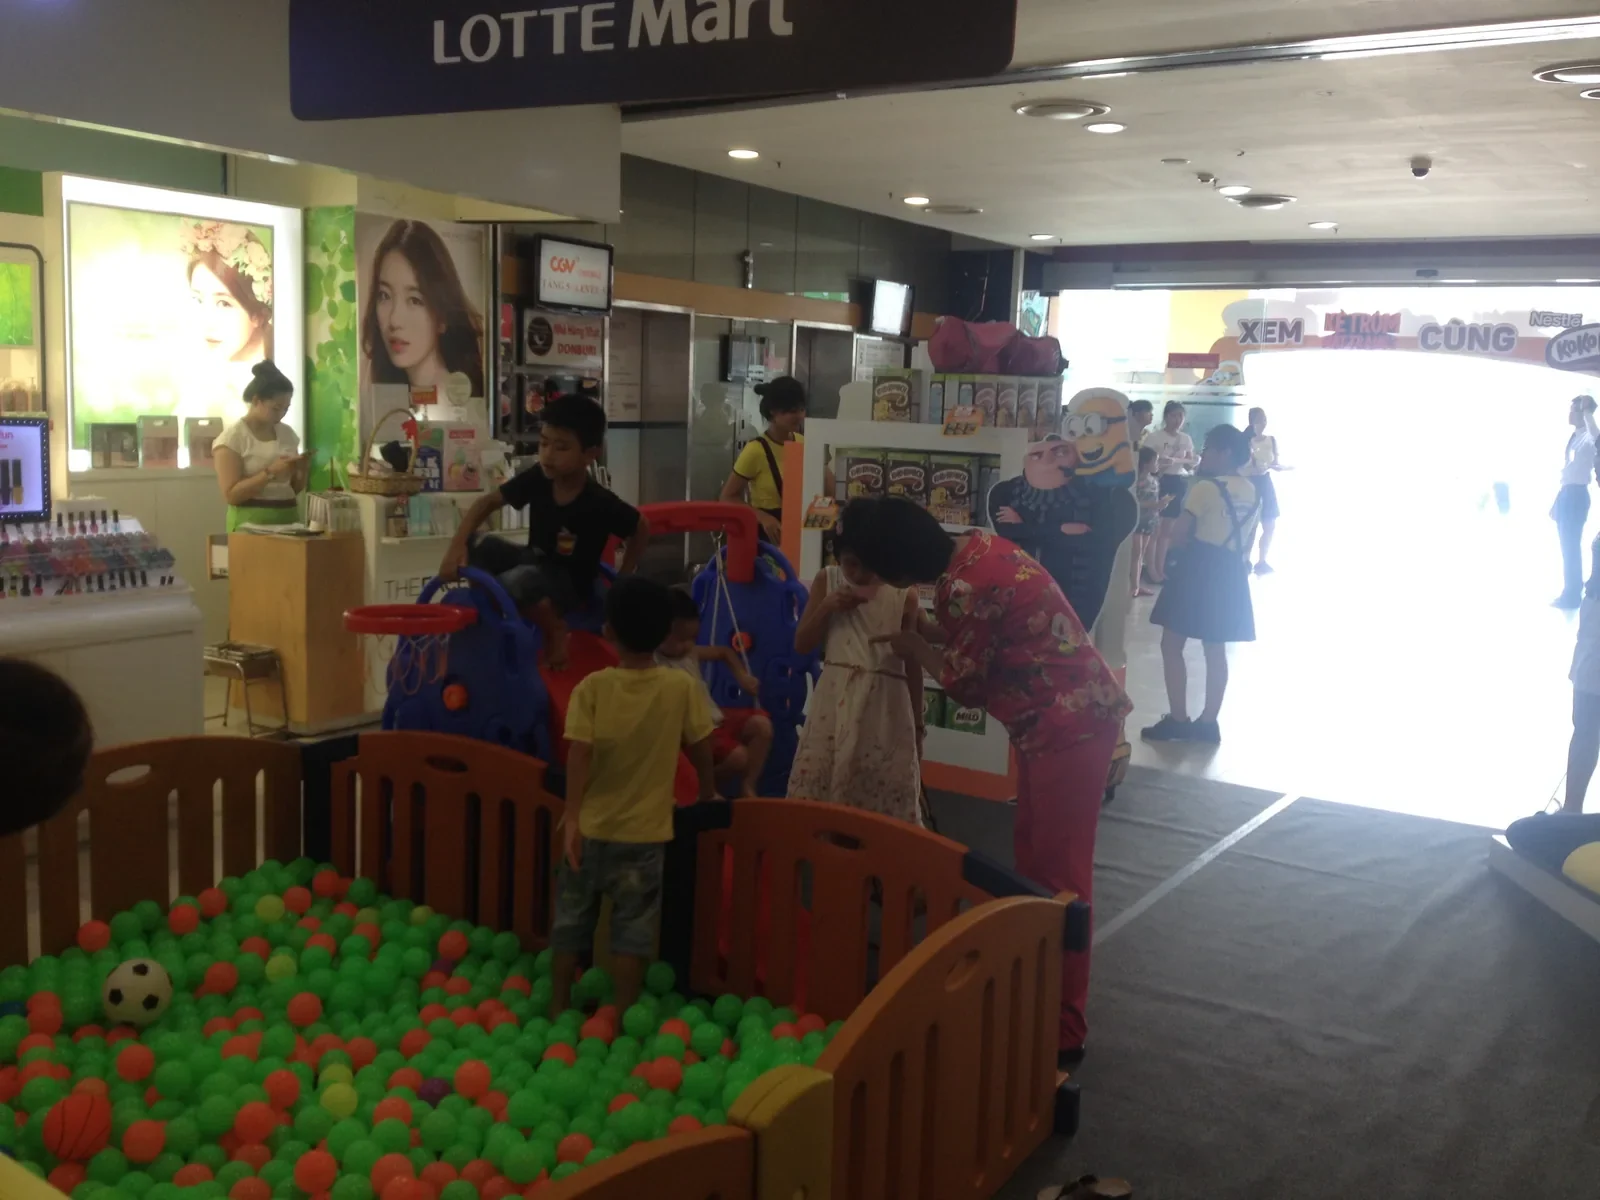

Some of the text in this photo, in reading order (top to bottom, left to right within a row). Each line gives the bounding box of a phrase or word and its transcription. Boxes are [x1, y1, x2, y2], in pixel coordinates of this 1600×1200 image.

[433, 0, 793, 64] LOTTE Mart
[550, 255, 576, 273] CGV
[1238, 319, 1304, 344] XEM
[1419, 318, 1517, 352] CÙNG
[557, 343, 597, 356] DONBURI
[955, 711, 979, 722] MILO
